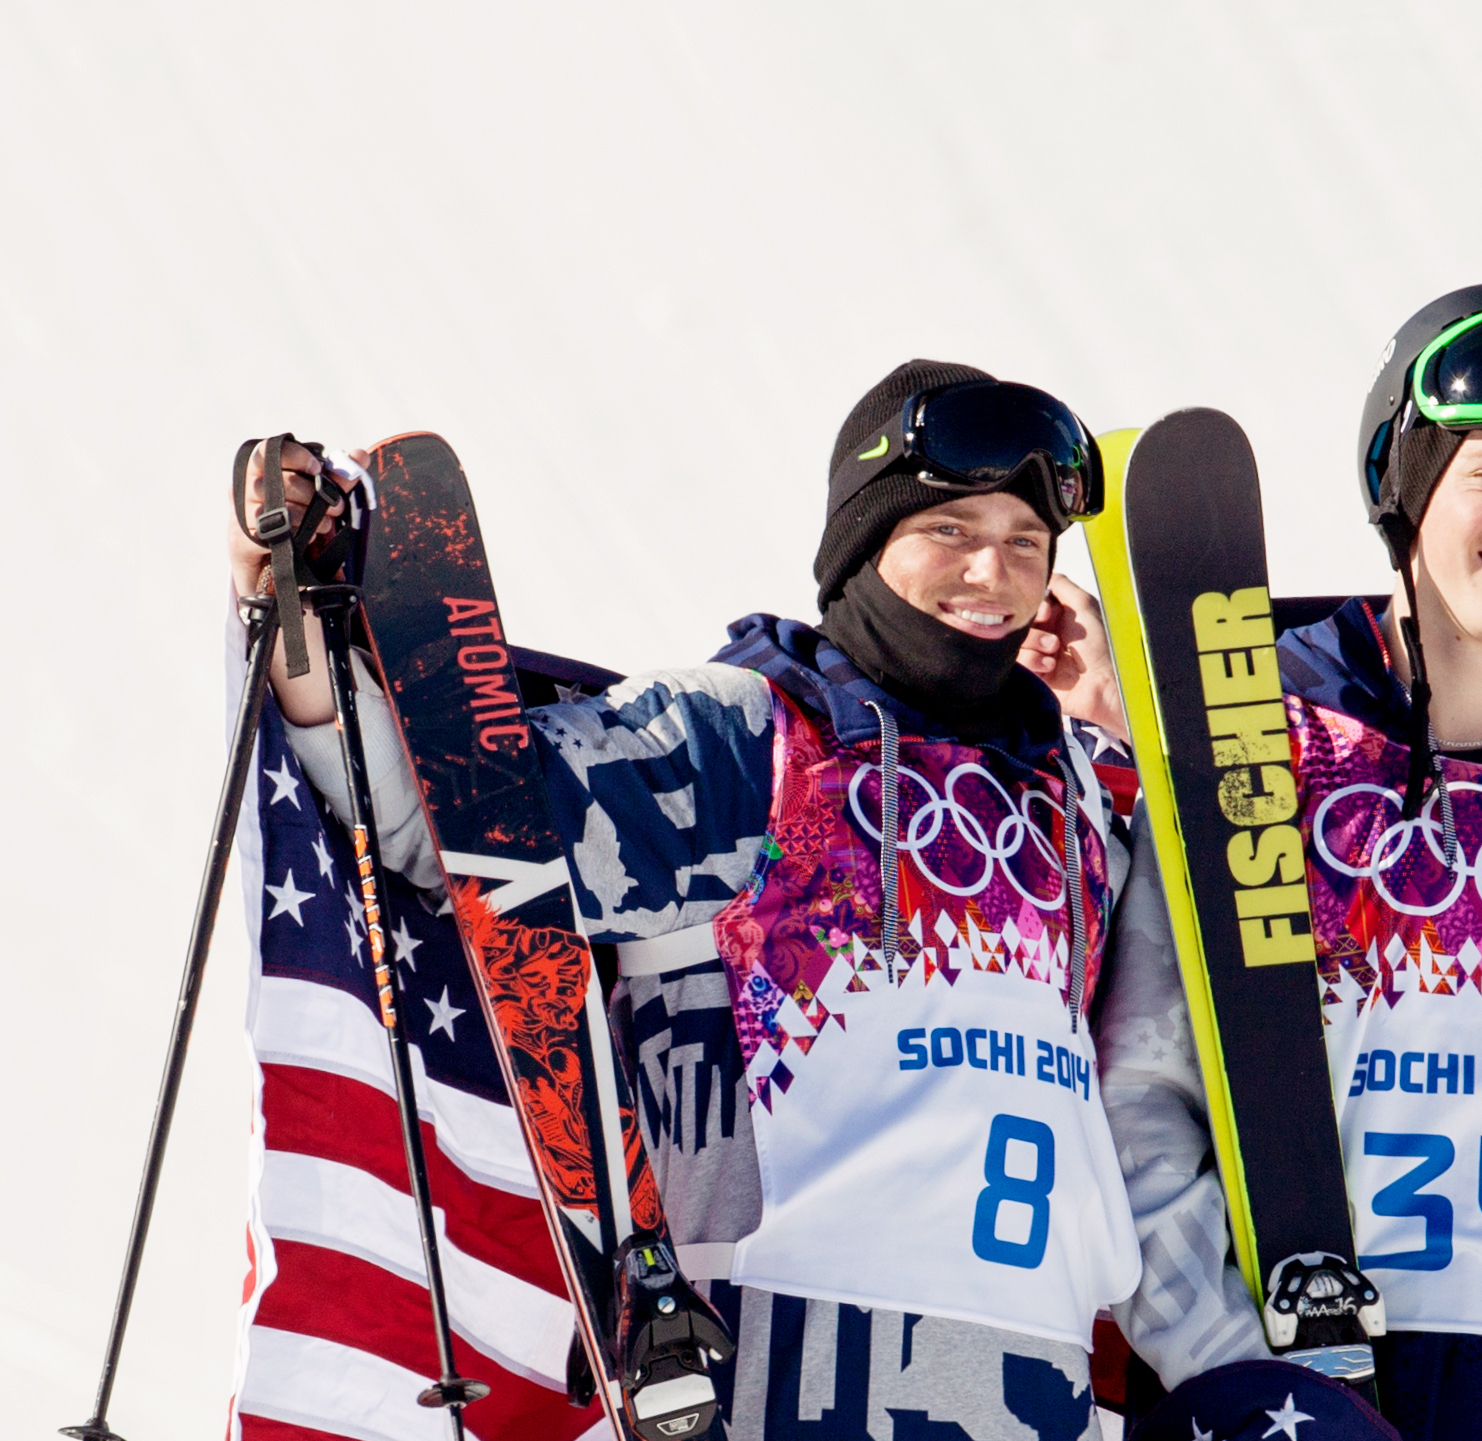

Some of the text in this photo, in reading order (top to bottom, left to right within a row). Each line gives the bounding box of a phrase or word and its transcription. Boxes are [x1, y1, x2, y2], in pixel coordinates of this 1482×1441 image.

[442, 597, 529, 755] ATOMIC
[1191, 586, 1316, 968] FISCHER
[896, 1026, 1090, 1102] SOCHI 2014
[1347, 1048, 1476, 1098] SOCHI
[971, 1113, 1056, 1270] 8
